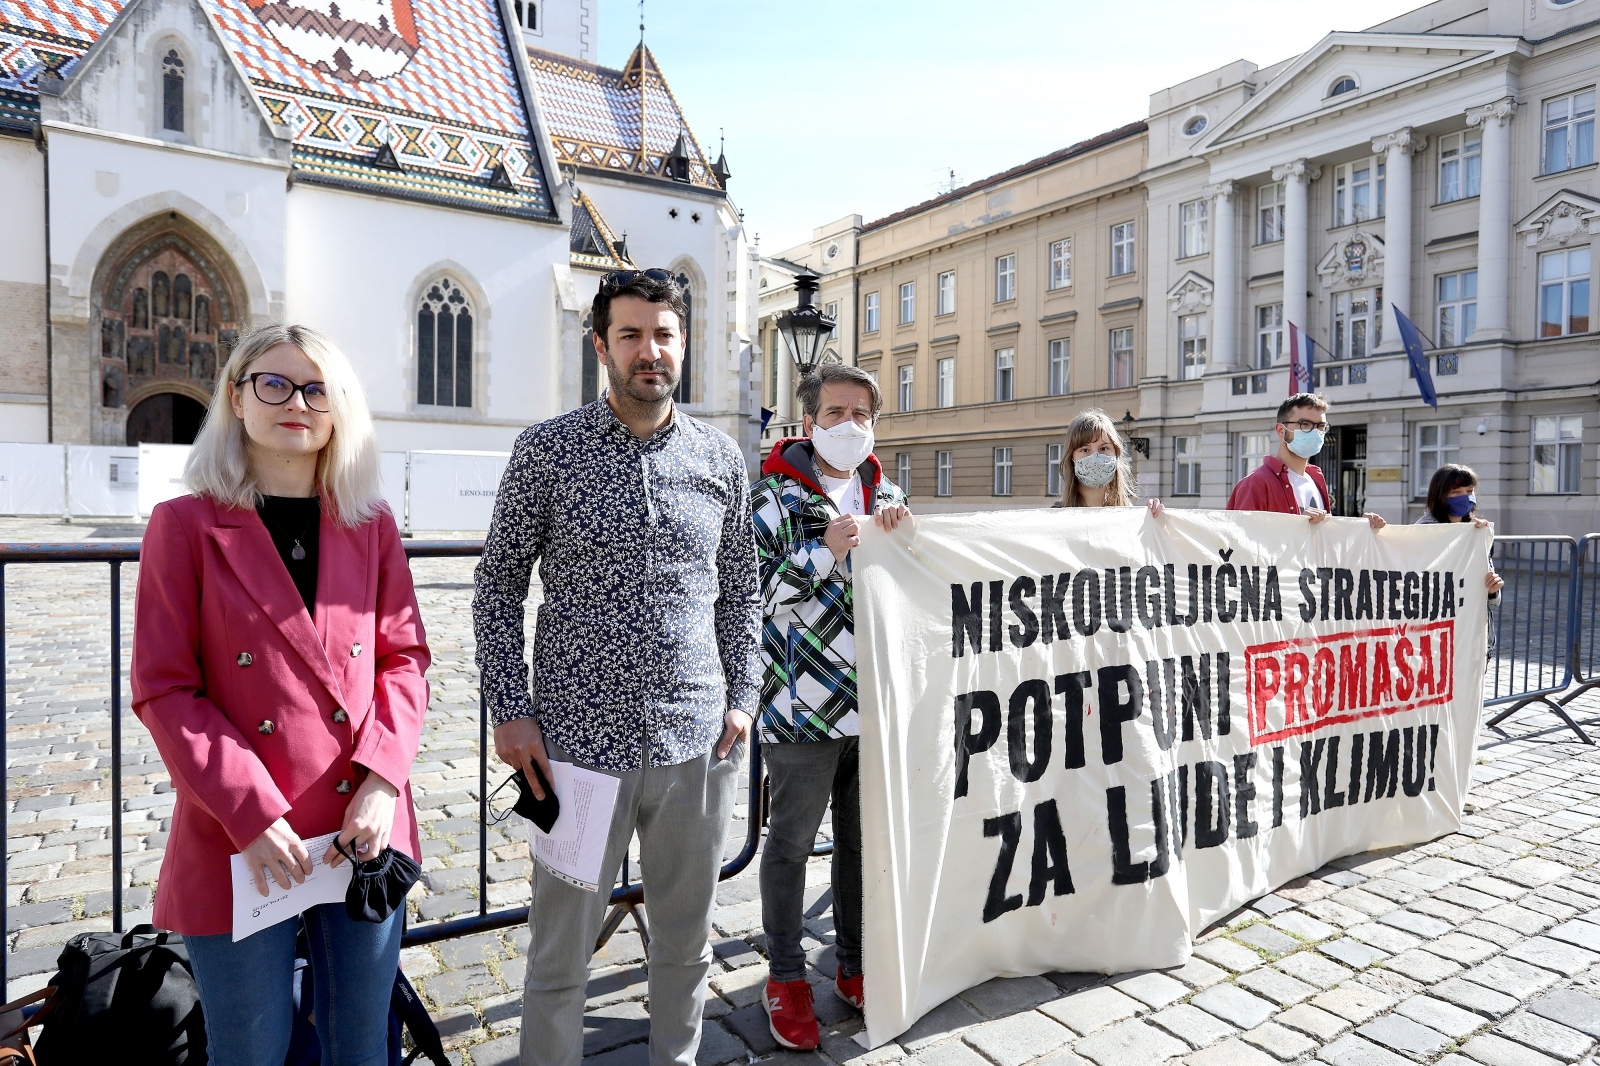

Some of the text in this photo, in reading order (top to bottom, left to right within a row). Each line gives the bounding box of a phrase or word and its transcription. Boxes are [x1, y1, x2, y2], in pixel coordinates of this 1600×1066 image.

[951, 548, 1464, 658] NISKOUGLJIČNA STRATEGIJA:
[954, 622, 1447, 799] POTPUNI PROMAŠAJ
[983, 724, 1439, 923] ZA LJUDE I KLIMU!
